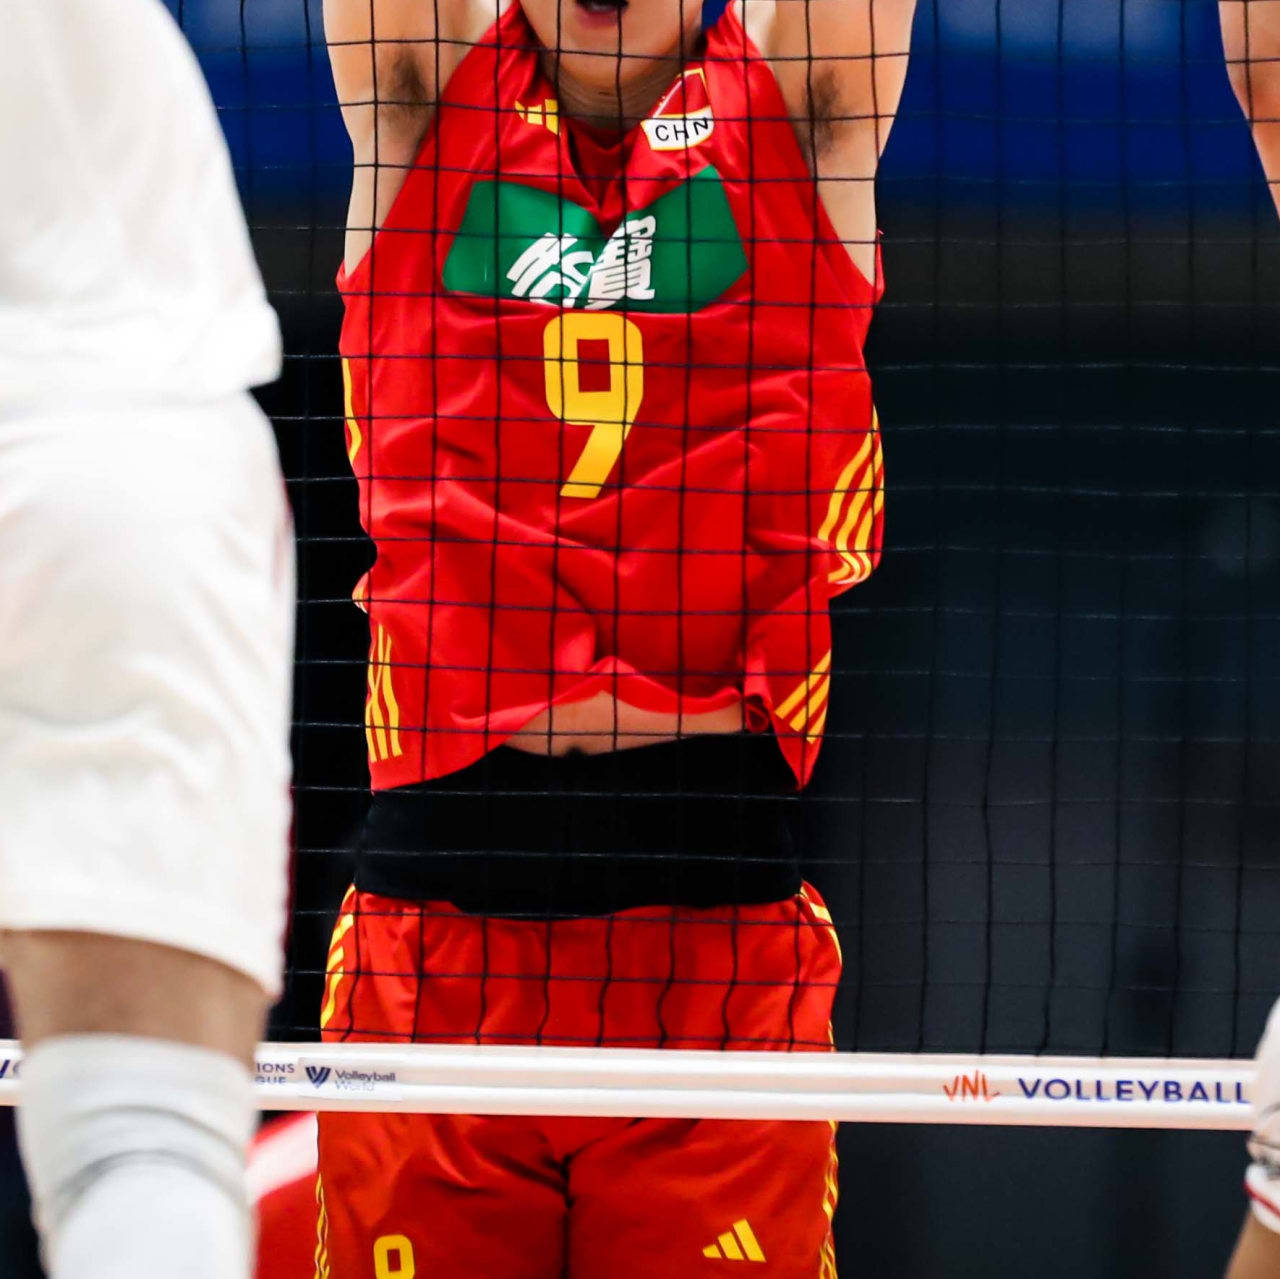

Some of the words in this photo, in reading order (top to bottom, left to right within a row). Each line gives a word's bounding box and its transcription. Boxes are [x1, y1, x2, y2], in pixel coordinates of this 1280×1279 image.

[655, 117, 710, 143] CHN
[543, 312, 645, 499] 9
[255, 1062, 295, 1074] IONS
[334, 1069, 396, 1082] Volleyball
[942, 1069, 1001, 1102] VNL
[1017, 1078, 1252, 1104] VOLLEYBALL
